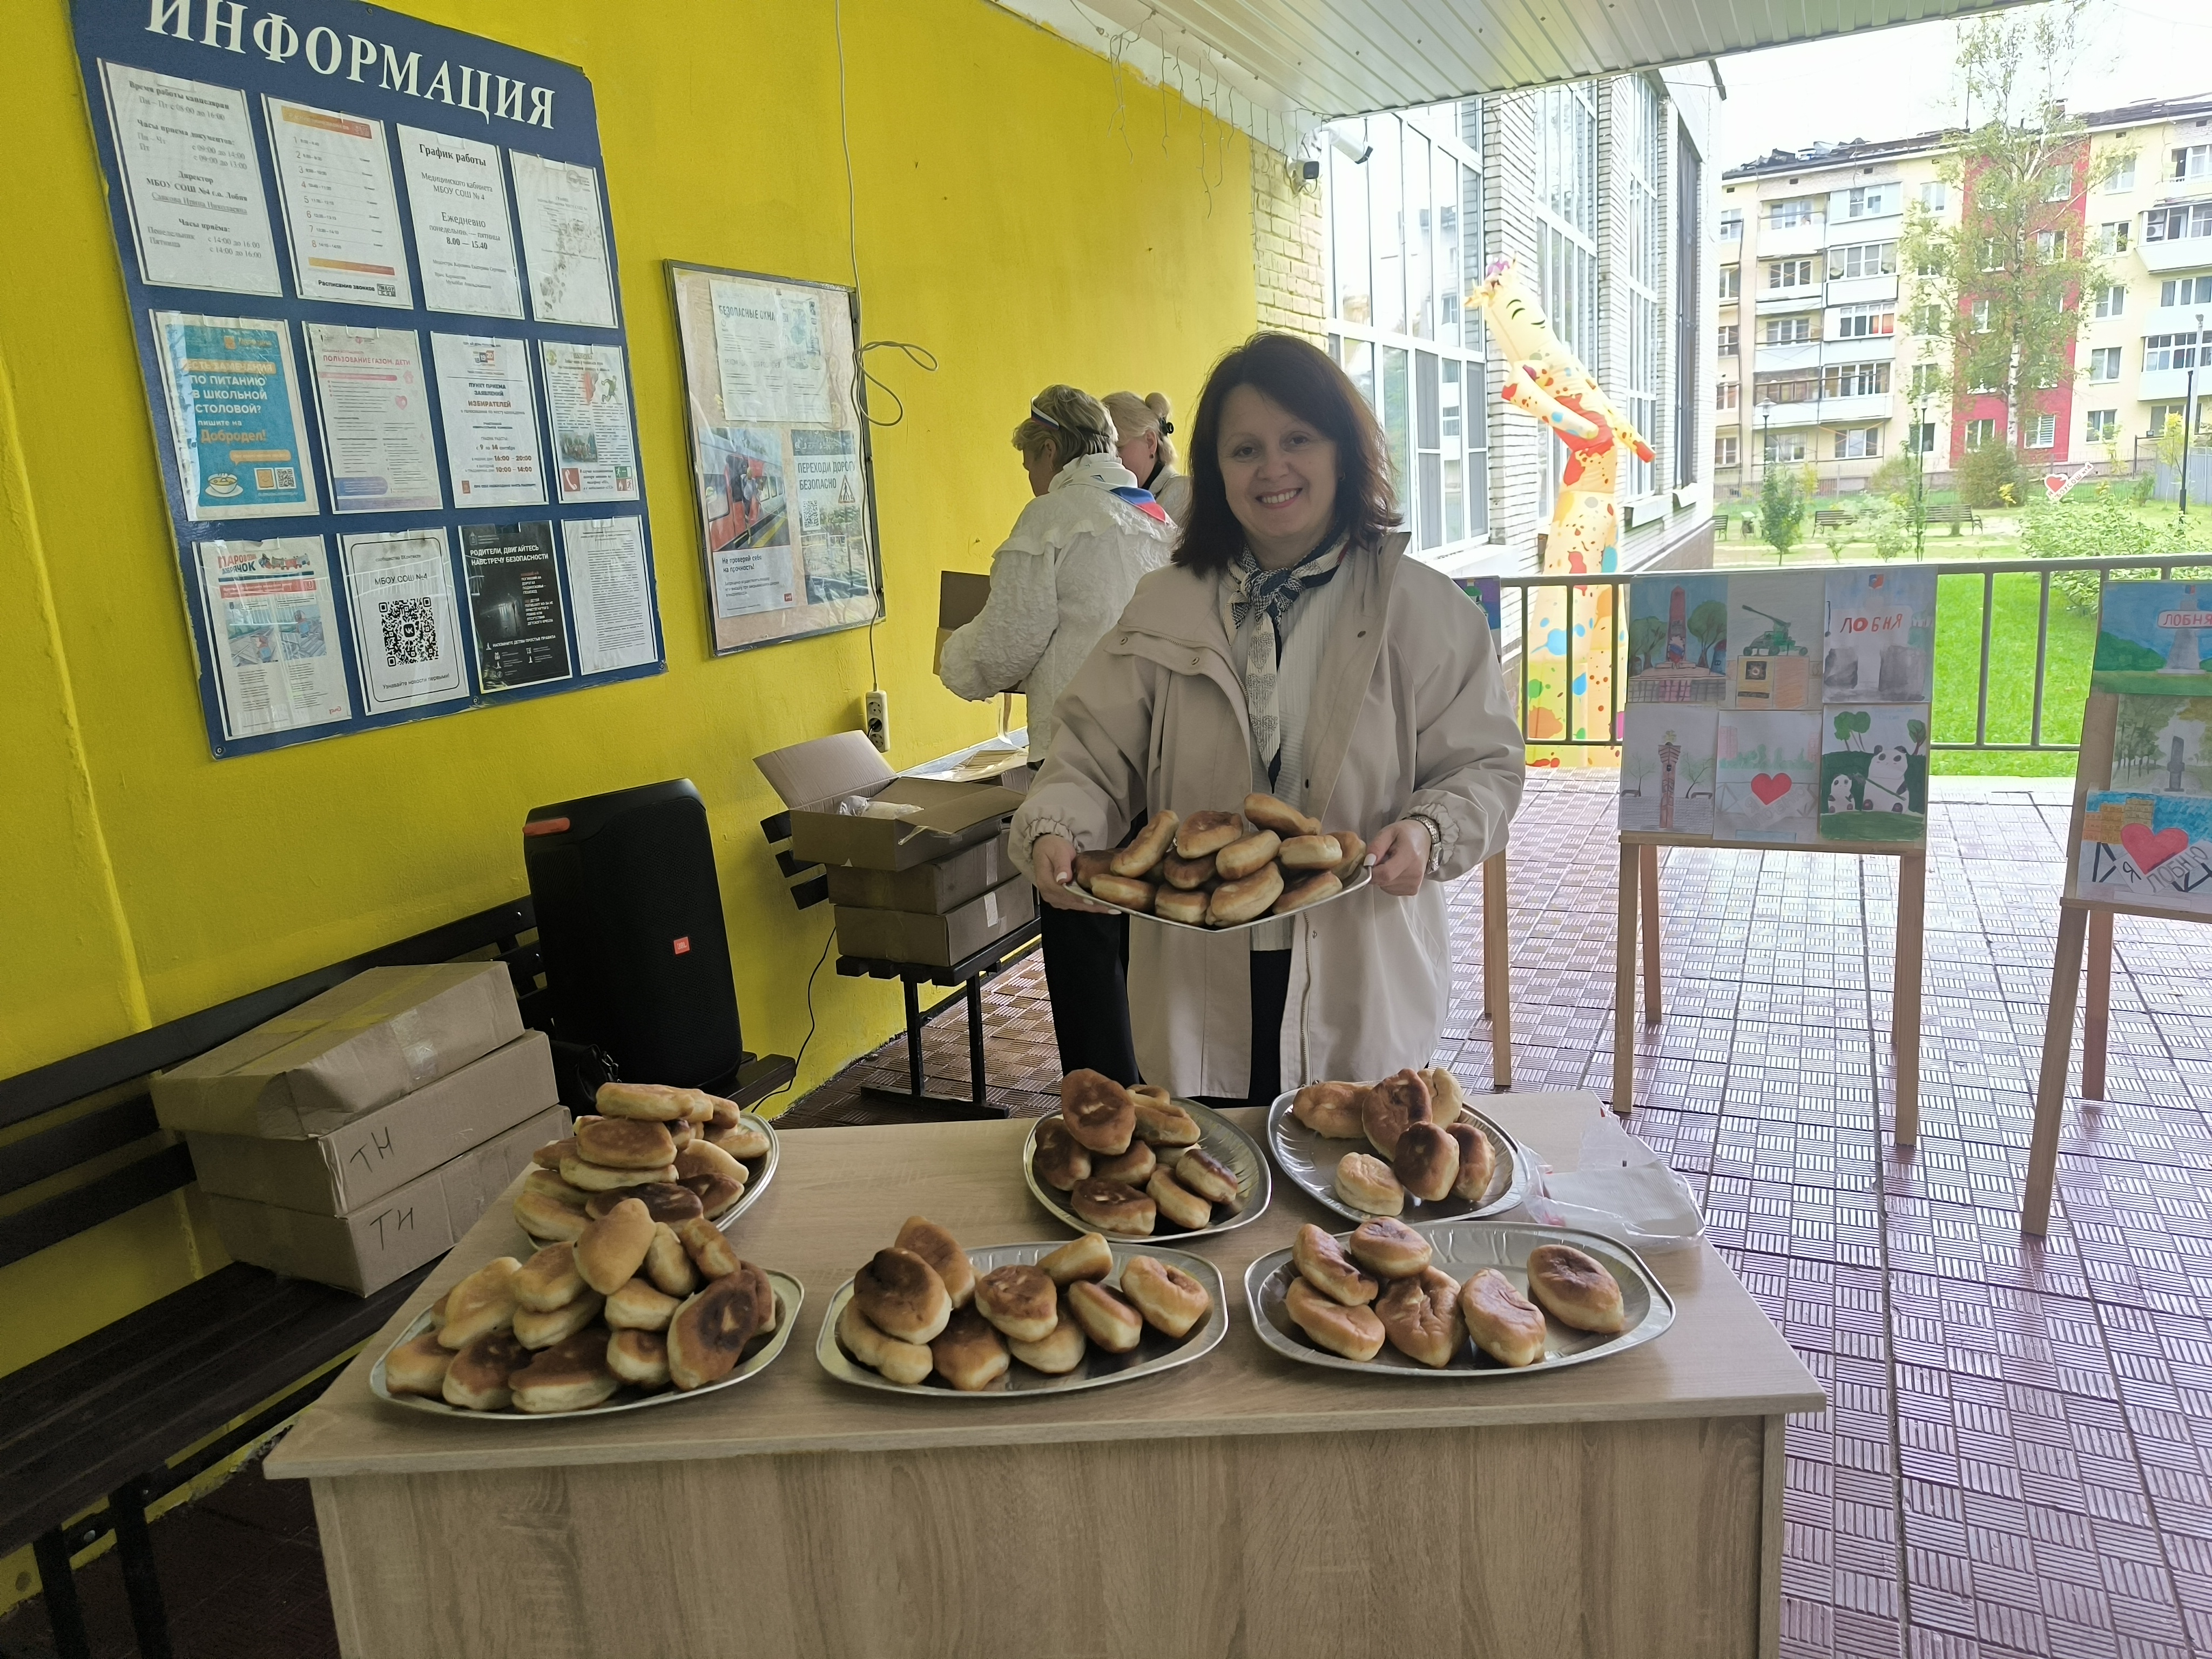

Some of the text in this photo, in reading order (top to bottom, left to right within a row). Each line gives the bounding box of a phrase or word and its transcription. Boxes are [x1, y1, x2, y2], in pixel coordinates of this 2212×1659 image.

[145, 0, 555, 130] ИНФОРМАЦИЯ
[156, 88, 184, 99] работы
[137, 119, 159, 130] Часы
[295, 151, 301, 159] 2
[419, 144, 486, 166] График работы
[298, 165, 304, 173] 3
[178, 171, 213, 185] Директор
[421, 172, 493, 192] Медицинского кабинета
[146, 178, 170, 188] МБОУ
[174, 183, 196, 193] СОШ
[433, 185, 453, 194] МБОУ
[455, 188, 471, 198] СОШ
[178, 218, 199, 227] Часы
[441, 212, 486, 227] Ежедневно
[309, 225, 313, 233] 7
[312, 240, 317, 248] 8
[447, 237, 460, 245] 8.00
[472, 240, 488, 249] 15.40
[318, 280, 352, 289] Расписание
[719, 305, 759, 319] БЕЗОПАСНЫЕ
[323, 355, 371, 363] ПОЛЬЗОВАНИЕ
[210, 375, 266, 386] ПИТАНИЮ
[203, 389, 267, 400] ШКОЛЬНОЙ
[195, 403, 261, 414] СТОЛОВОЙ?
[200, 429, 266, 444] Добродел!
[798, 461, 855, 474] ПЕРЕХОДИ ДОРОГУ
[799, 478, 837, 490] БЕЗОПАСНО
[470, 544, 539, 557] РОДИТЕЛИ, ДВИГАЙТЕСЬ
[471, 553, 549, 566] НАВСТРЕЧУ БЕЗОПАСНОСТИ
[730, 555, 751, 564] проверяй
[730, 563, 754, 573] прочность!
[375, 576, 395, 585] МБОУ
[416, 572, 428, 581] №4
[1839, 613, 1903, 633] ЛОБНЯ
[2162, 613, 2212, 626] ЛОБНЯ
[382, 681, 407, 690] Узнавайте
[2122, 846, 2209, 893] Я ЛОБНЮ
[677, 942, 687, 950] JBL
